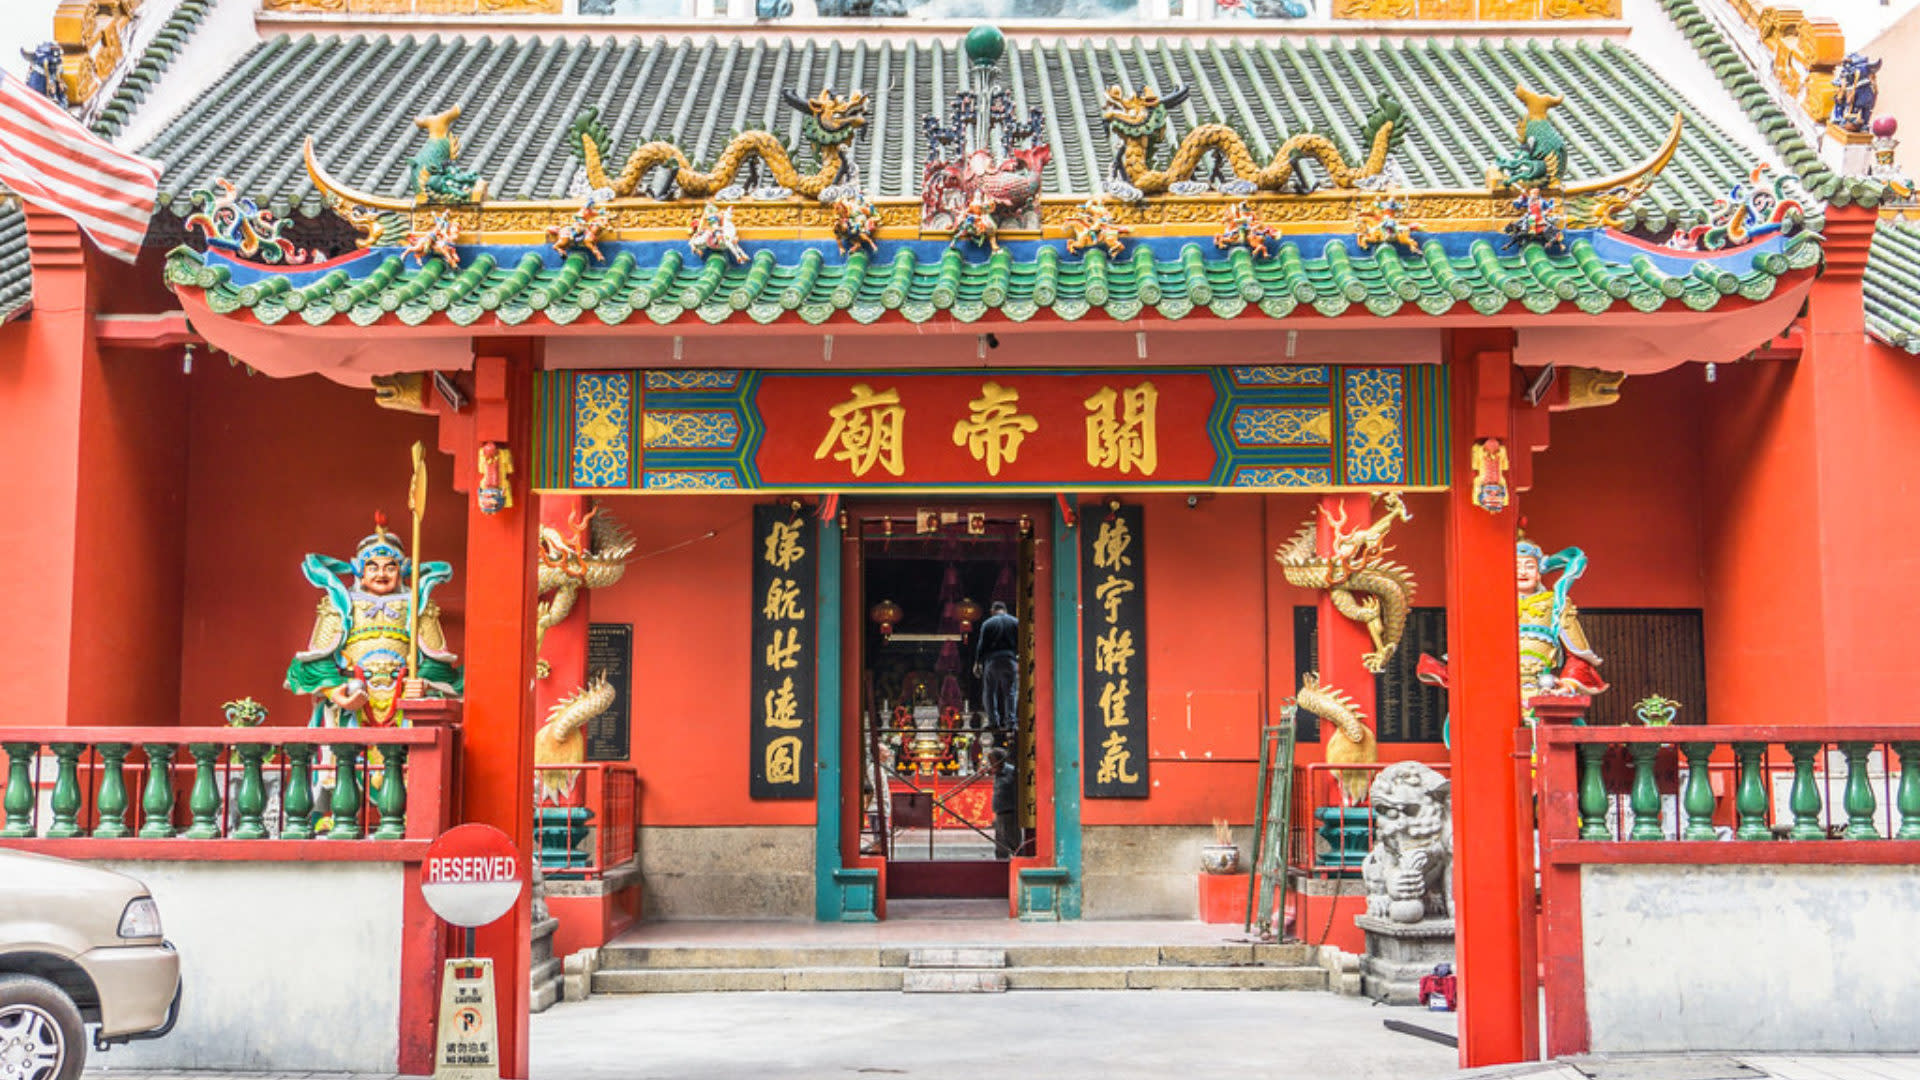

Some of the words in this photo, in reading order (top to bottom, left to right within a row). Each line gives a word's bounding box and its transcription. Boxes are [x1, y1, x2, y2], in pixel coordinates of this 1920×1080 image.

[429, 857, 516, 882] RESERVED
[446, 1055, 456, 1063] NO
[458, 1055, 489, 1064] PARKING
